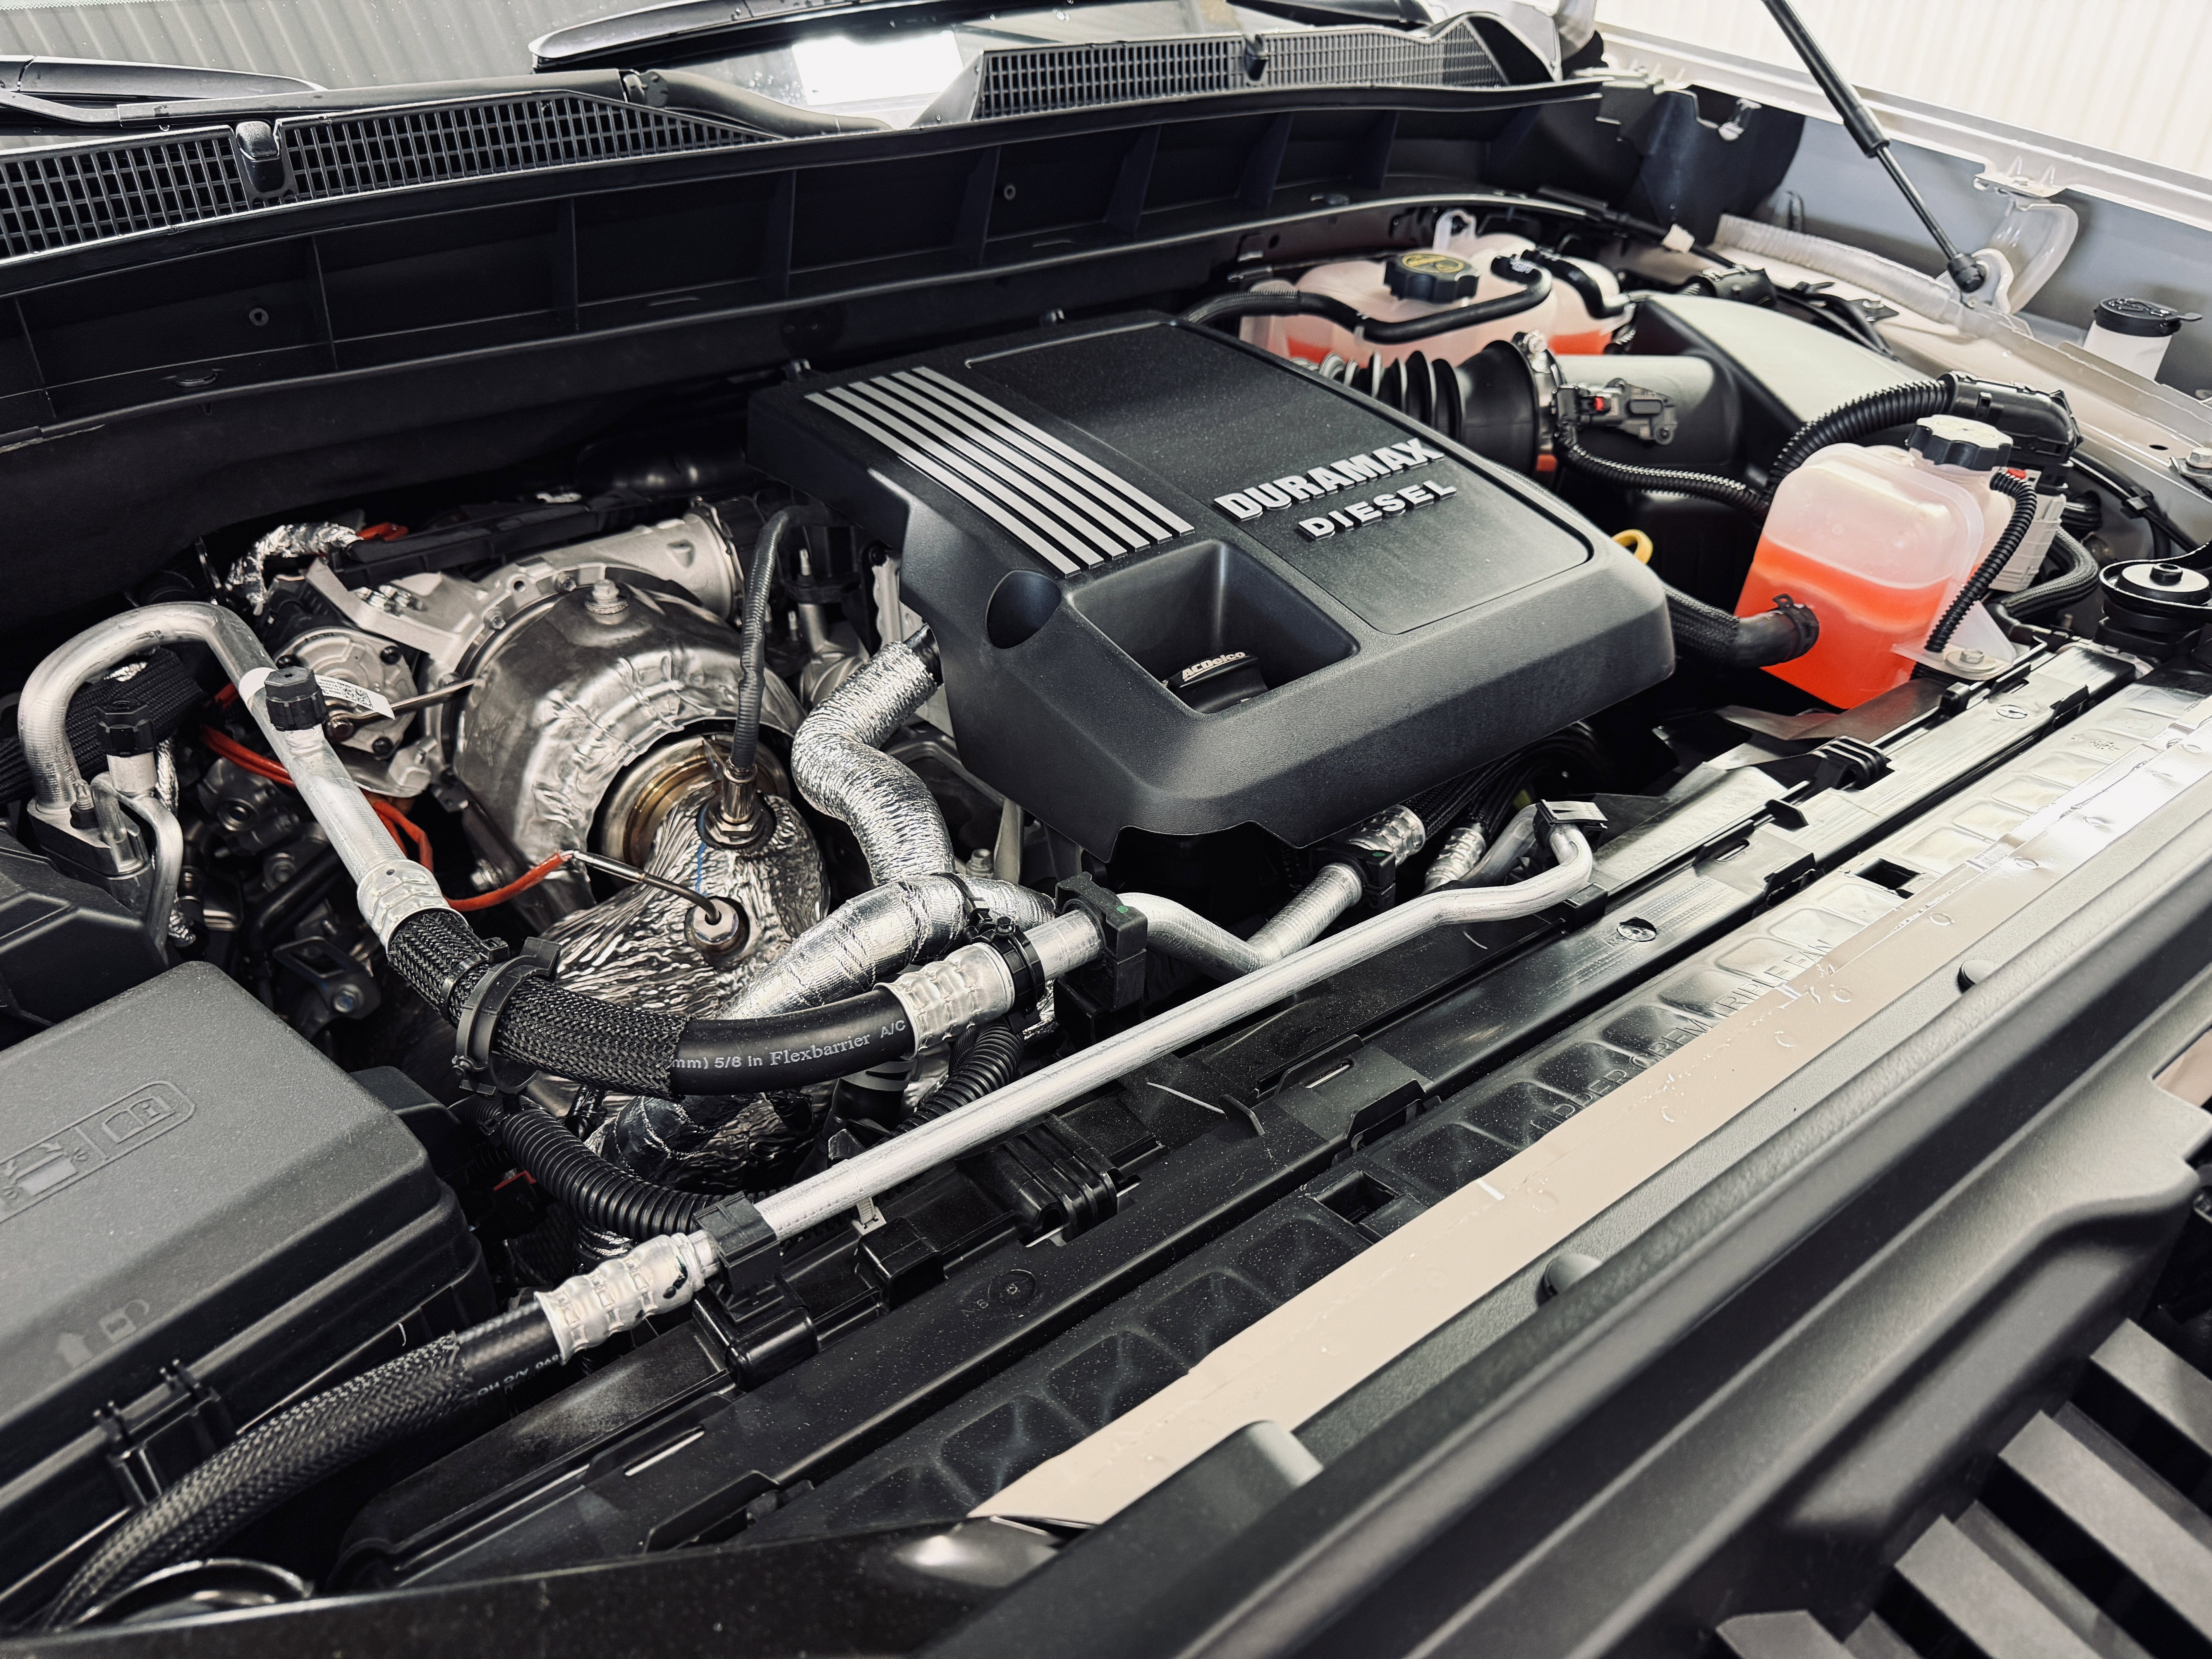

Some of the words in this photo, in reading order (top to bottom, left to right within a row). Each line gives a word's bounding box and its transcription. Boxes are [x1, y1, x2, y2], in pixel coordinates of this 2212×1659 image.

[1214, 438, 1445, 521] DURAMAX
[1297, 480, 1457, 541] DIESEL
[1182, 651, 1247, 680] ACDelco
[672, 1057, 709, 1069] mm)
[714, 1056, 742, 1068] 5/8
[748, 1056, 763, 1067] in
[768, 1034, 871, 1066] Flexbarrier
[879, 1020, 906, 1039] A/C
